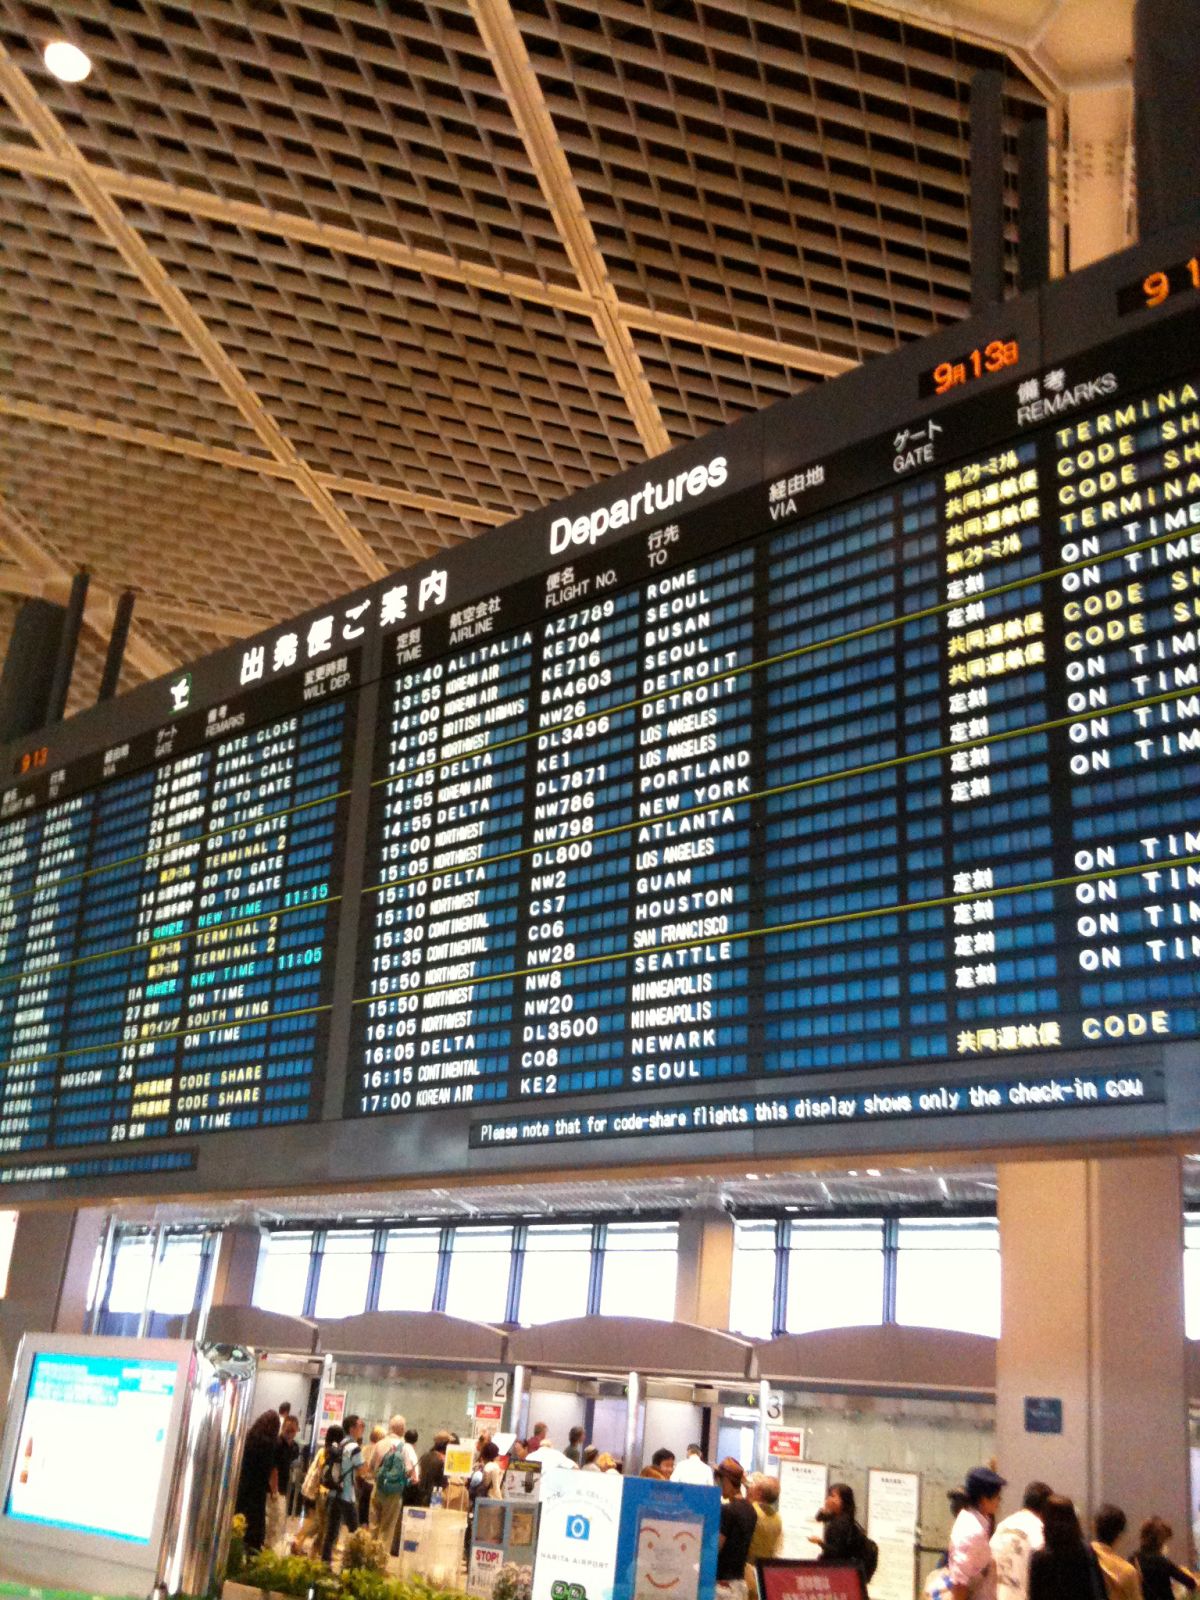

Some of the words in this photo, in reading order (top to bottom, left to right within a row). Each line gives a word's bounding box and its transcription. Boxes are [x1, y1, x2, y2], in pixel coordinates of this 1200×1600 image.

[1017, 373, 1117, 426] REMARKS
[893, 443, 933, 473] GATE
[1057, 435, 1134, 476] CODE
[769, 465, 824, 502] 経由地
[549, 456, 729, 556] Departures
[769, 498, 797, 520] VIA
[648, 525, 679, 551] 行先
[1061, 536, 1100, 563] ON
[647, 549, 668, 568] TO
[1062, 565, 1100, 592] ON
[545, 579, 590, 609] FLIGHT
[596, 570, 617, 589] NO.
[546, 567, 574, 592] 便名
[239, 570, 448, 686] 出発便ご案内
[396, 664, 443, 692] 13:40
[448, 632, 532, 673] ALITALIA
[545, 600, 614, 637] AZ7789
[647, 569, 696, 600] ROME
[449, 617, 493, 645] AIRLINE
[450, 596, 501, 629] 航空会社
[394, 684, 441, 713] 13:55
[543, 627, 601, 660] KE704
[646, 590, 710, 623] SEOUL
[396, 644, 422, 665] TIME
[1066, 655, 1105, 681] ON
[303, 683, 326, 700] WILL
[330, 672, 350, 691] DEP.
[392, 706, 440, 734] 14:00
[542, 650, 600, 682] KE716
[645, 612, 710, 647] BUSAN
[389, 748, 436, 775] 14:45
[441, 731, 491, 759] NORTHWEST
[539, 700, 586, 727] NW26
[643, 651, 737, 695] DETROIT
[390, 727, 438, 754] 14:05
[484, 698, 525, 724] AIRWAYS
[541, 669, 611, 705] BA4603
[645, 638, 709, 670] SEOUL
[218, 736, 248, 757] GATE
[256, 718, 297, 743] CLOSE
[387, 769, 435, 796] 14:45
[440, 753, 492, 780] DELTA
[538, 716, 609, 750] DL3496
[642, 677, 736, 719] DETROIT
[154, 782, 168, 799] 24
[216, 753, 254, 775] FINAL
[262, 739, 295, 759] CALL
[385, 791, 433, 818] 14:55
[537, 751, 570, 773] KE1
[640, 724, 663, 745] LOS
[667, 708, 718, 736] ANGELES
[211, 797, 228, 813] GO
[235, 790, 251, 804] TO
[258, 776, 291, 797] GATE
[382, 835, 431, 861] 15:00
[535, 791, 595, 820] NW786
[640, 750, 750, 792] PORTLAND
[384, 813, 432, 839] 14:55
[437, 798, 490, 824] DELTA
[536, 764, 606, 797] DL7871
[639, 749, 662, 770] LOS
[666, 733, 717, 762] ANGELES
[380, 857, 428, 883] 15:05
[534, 816, 594, 843] NW798
[639, 794, 680, 817] NEW
[694, 776, 749, 803] YORK
[206, 842, 268, 869] TERMINAL
[277, 835, 286, 850] 2
[378, 880, 427, 905] 15:10
[432, 866, 485, 891] DELTA
[532, 840, 592, 868] DL800
[638, 807, 734, 843] ATLANTA
[376, 902, 425, 927] 15:10
[430, 890, 481, 915] NORTHWEST
[531, 870, 566, 892] NW2
[636, 850, 659, 870] LOS
[663, 837, 715, 864] ANGELES
[198, 911, 222, 927] NEW
[231, 900, 261, 919] TIME
[285, 883, 328, 907] 11:15
[374, 925, 424, 949] 15:30
[428, 912, 490, 939] CONTINENTAL
[529, 895, 565, 916] CS7
[637, 868, 691, 894] GUAM
[372, 948, 421, 972] 15:35
[528, 920, 564, 941] CO6
[636, 887, 733, 920] HOUSTON
[279, 947, 322, 970] 11:05
[371, 971, 421, 995] 15:50
[527, 943, 575, 966] NW28
[634, 928, 657, 949] SAN
[660, 915, 729, 943] FRANCISCO
[1079, 946, 1121, 971] ON
[369, 995, 419, 1018] 15:50
[526, 970, 562, 991] NW8
[635, 942, 731, 973] SEATTLE
[126, 1005, 141, 1022] 27
[188, 993, 204, 1008] ON
[213, 984, 244, 1002] TIME
[187, 1009, 226, 1028] SOUTH
[235, 1001, 268, 1018] WING
[367, 1018, 416, 1041] 16:05
[421, 1010, 473, 1033] NORTHWEST
[524, 994, 573, 1016] NW20
[632, 973, 713, 1002] MINNEAPOLIS
[365, 1042, 415, 1064] 16:05
[420, 1034, 475, 1056] DELTA
[523, 1016, 598, 1042] DL3500
[631, 1001, 712, 1029] MINNEAPOLIS
[1082, 1010, 1169, 1039] CODE
[61, 1070, 102, 1087] MOSCOW
[118, 1064, 133, 1081] 24
[363, 1066, 413, 1088] 16:15
[418, 1059, 480, 1082] CONTINENTAL
[522, 1048, 558, 1068] CO8
[632, 1029, 715, 1054] NEWARK
[177, 1094, 209, 1111] CODE
[218, 1087, 259, 1106] SHARE
[362, 1091, 411, 1112] 17:00
[454, 1084, 474, 1102] AIR
[521, 1074, 557, 1093] KE2
[632, 1060, 700, 1082] SEOUL
[481, 1124, 518, 1141] Please
[522, 1121, 550, 1138] note
[555, 1118, 581, 1136] that
[586, 1116, 607, 1133] for
[613, 1111, 687, 1131] code-share
[693, 1105, 749, 1125] flights
[754, 1101, 788, 1122] this
[794, 1096, 857, 1118] display
[864, 1094, 912, 1114] shows
[919, 1087, 961, 1110] only
[968, 1085, 1002, 1107] the
[1009, 1078, 1098, 1104] check-in
[1105, 1078, 1143, 1098] cou
[494, 1377, 505, 1398] 2
[767, 1395, 780, 1419] 3
[475, 1549, 500, 1564] STOP!
